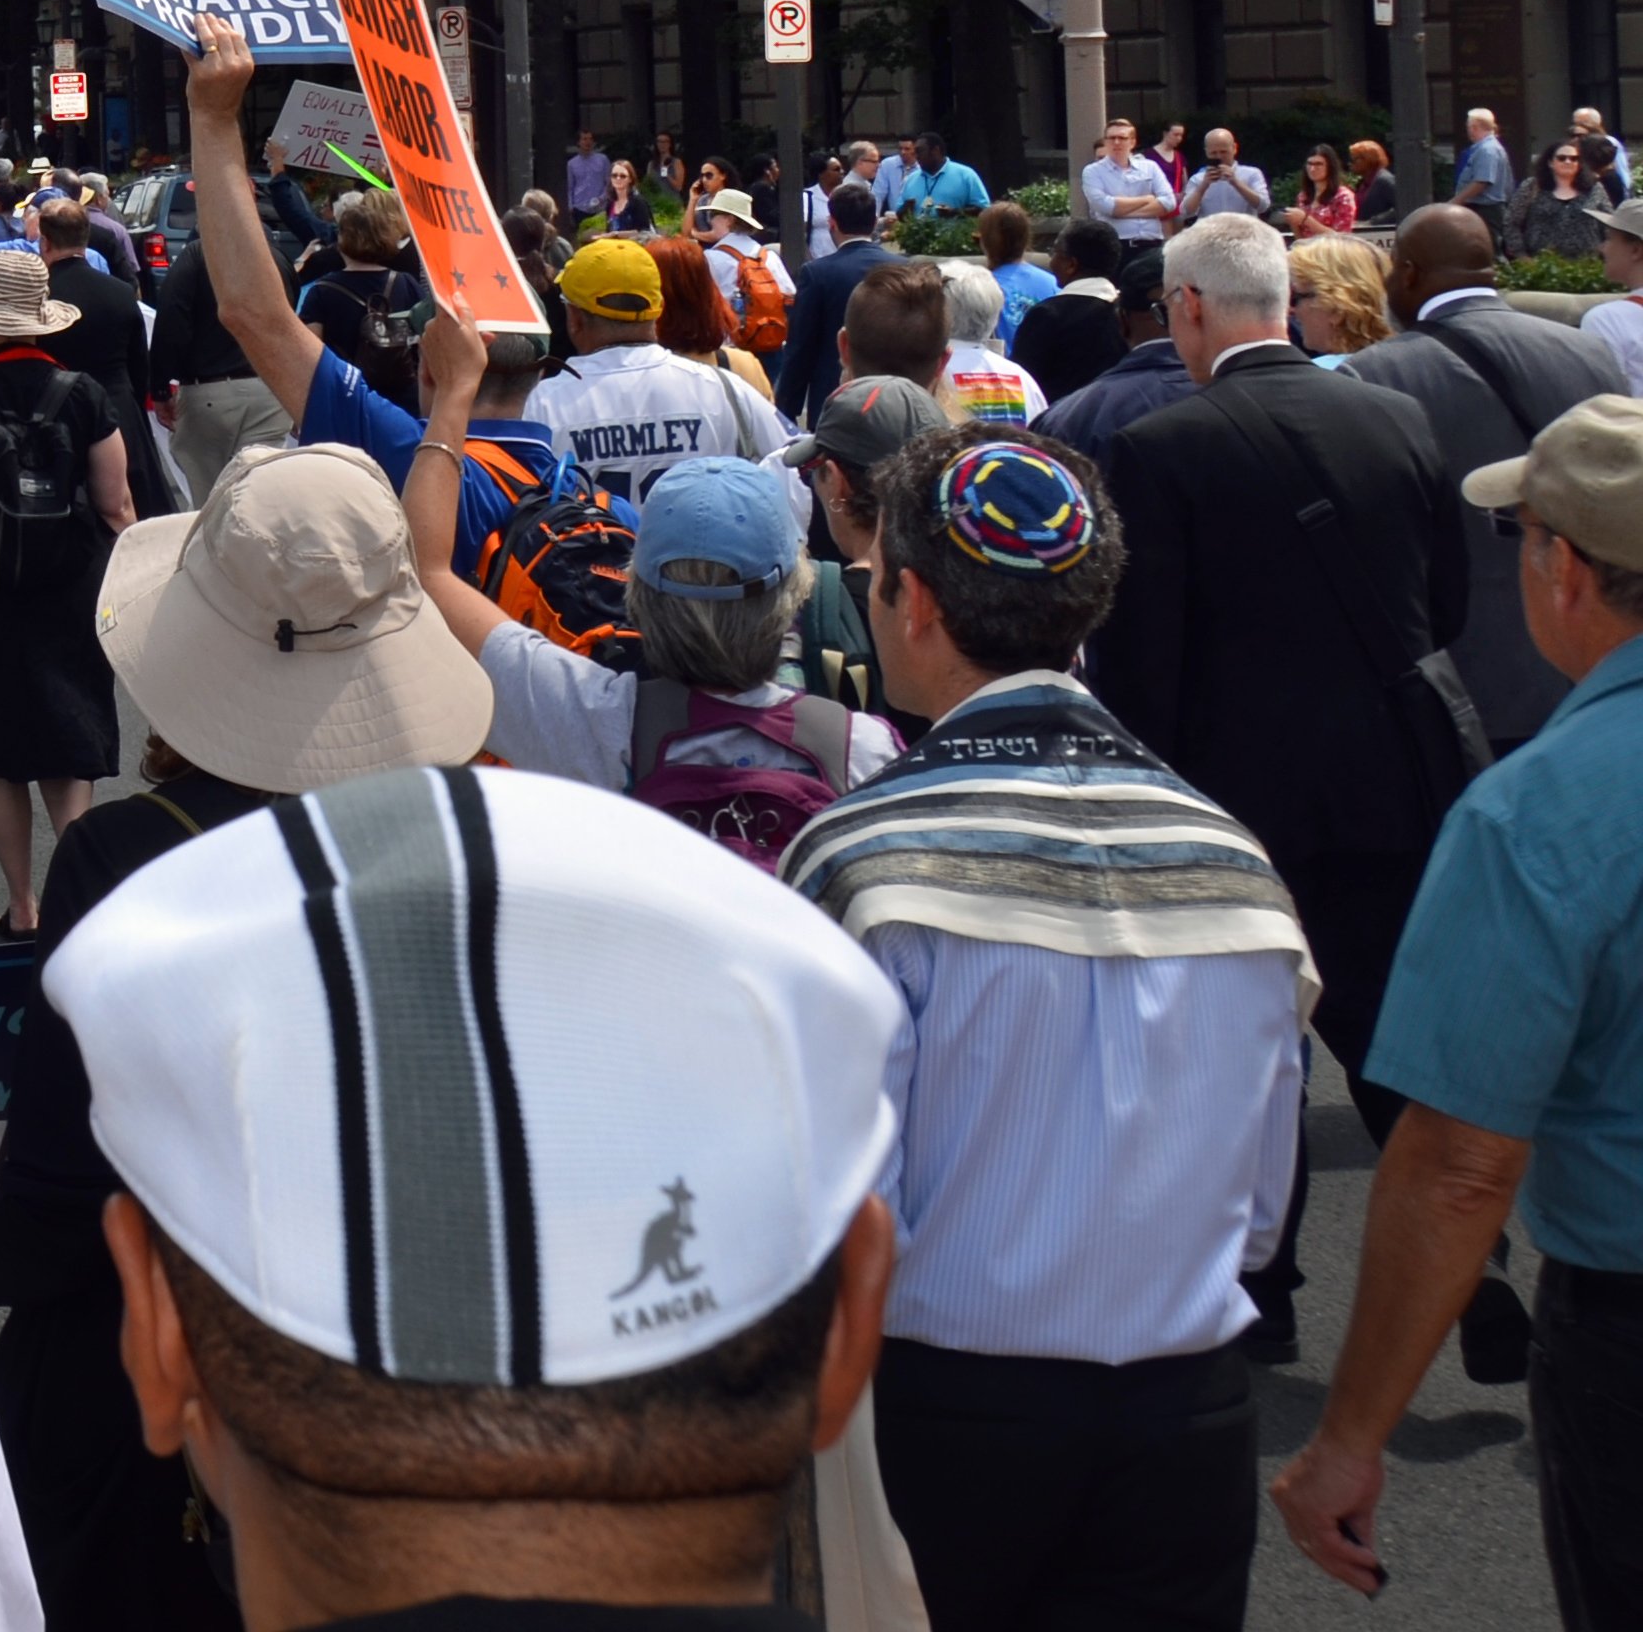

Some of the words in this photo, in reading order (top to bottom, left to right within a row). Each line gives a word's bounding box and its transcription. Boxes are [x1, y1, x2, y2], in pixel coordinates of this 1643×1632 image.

[359, 49, 453, 164] LABOR
[297, 124, 351, 144] JUSTICE
[293, 145, 331, 169] ALL
[569, 419, 702, 463] WORMLEY
[613, 1287, 719, 1336] KANGOL
